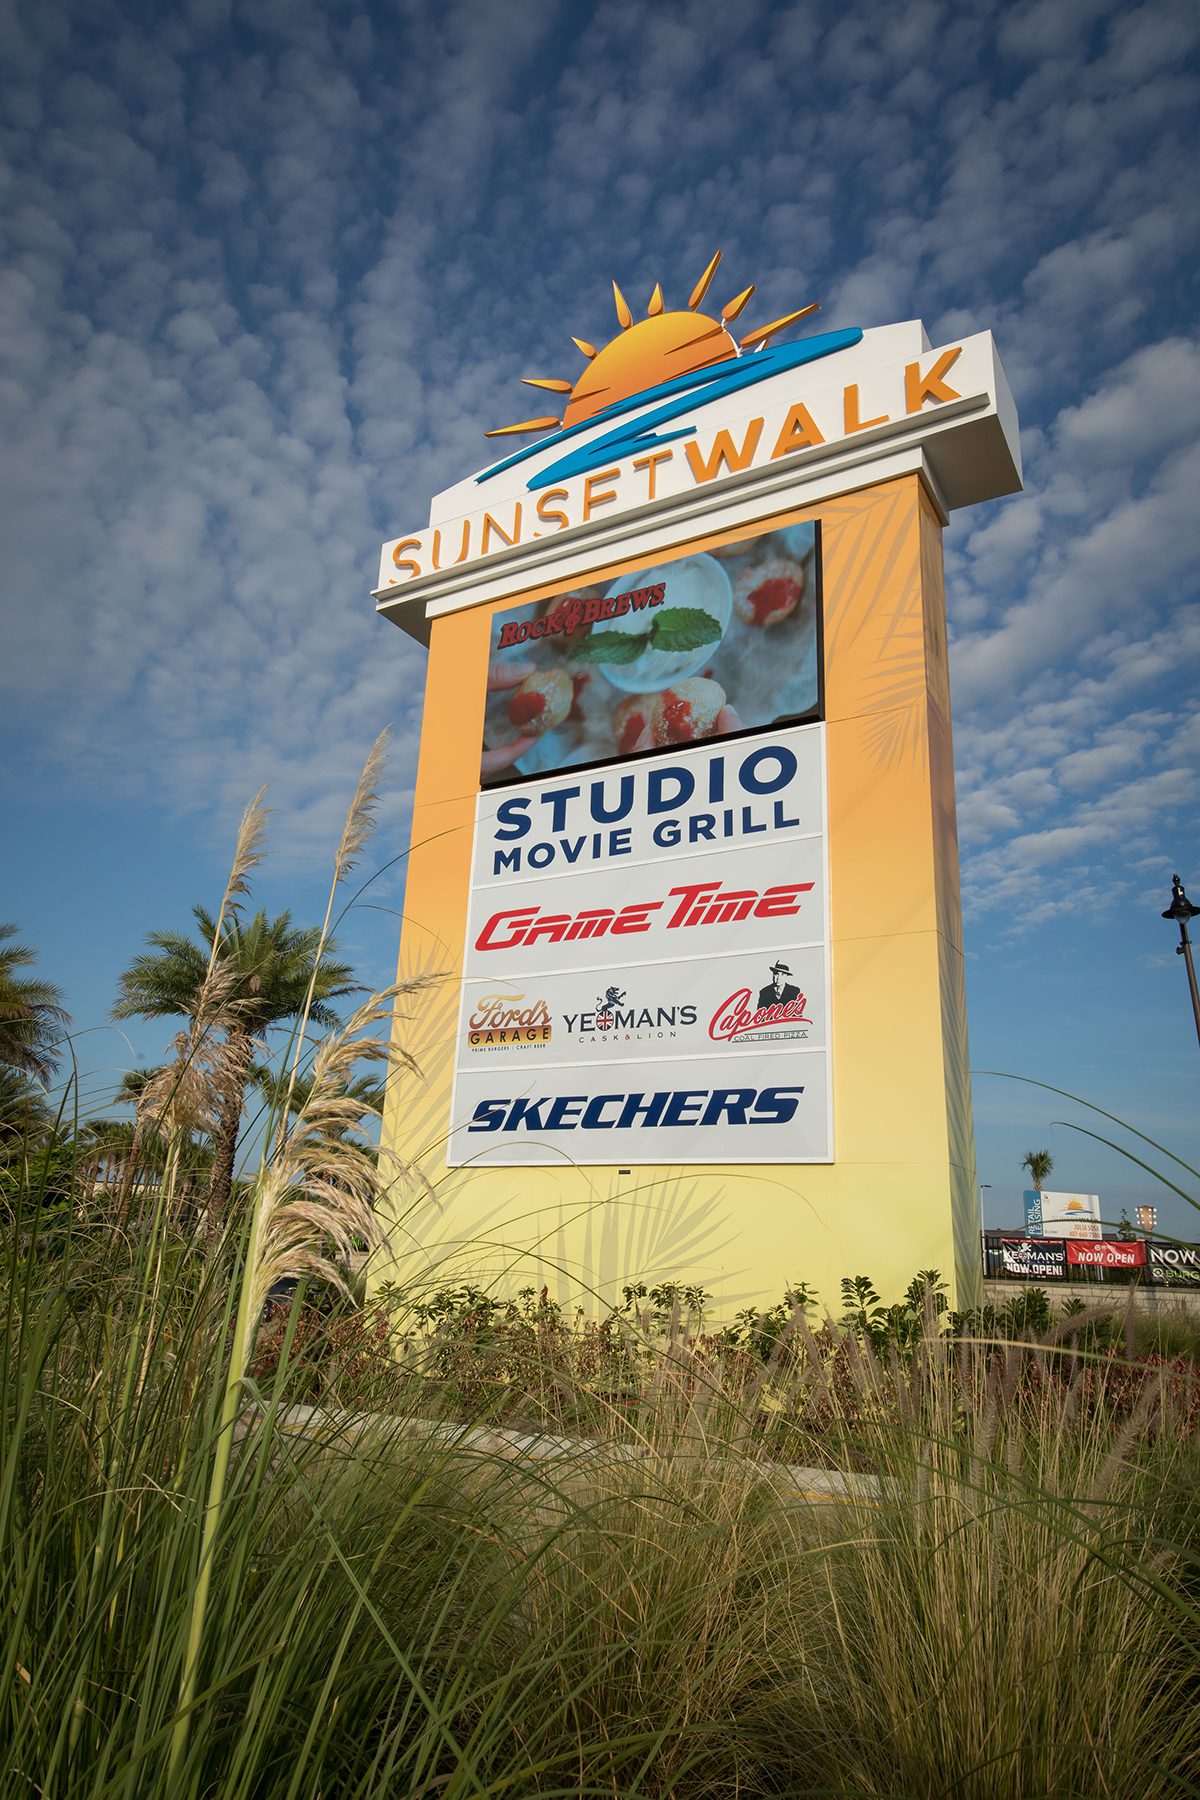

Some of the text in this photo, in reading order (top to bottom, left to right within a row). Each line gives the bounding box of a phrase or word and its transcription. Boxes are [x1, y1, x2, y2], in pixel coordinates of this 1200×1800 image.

[498, 612, 563, 649] ROCK
[582, 582, 667, 624] BREWS
[494, 745, 798, 841] STUDIO
[493, 800, 800, 875] MOVIE GRILL
[468, 993, 553, 1030] Ford's
[709, 988, 813, 1041] Capone's
[470, 1027, 550, 1045] GARAGE
[757, 1032, 781, 1040] FIRED
[783, 1031, 807, 1039] PIZZA
[467, 1086, 805, 1133] SKECHERS
[1027, 1207, 1035, 1235] RETAIL
[1034, 1199, 1042, 1235] LEASING
[1006, 1263, 1062, 1275] NOW OPEN!
[1078, 1252, 1135, 1264] NOW OPEN
[1151, 1249, 1196, 1264] NOW
